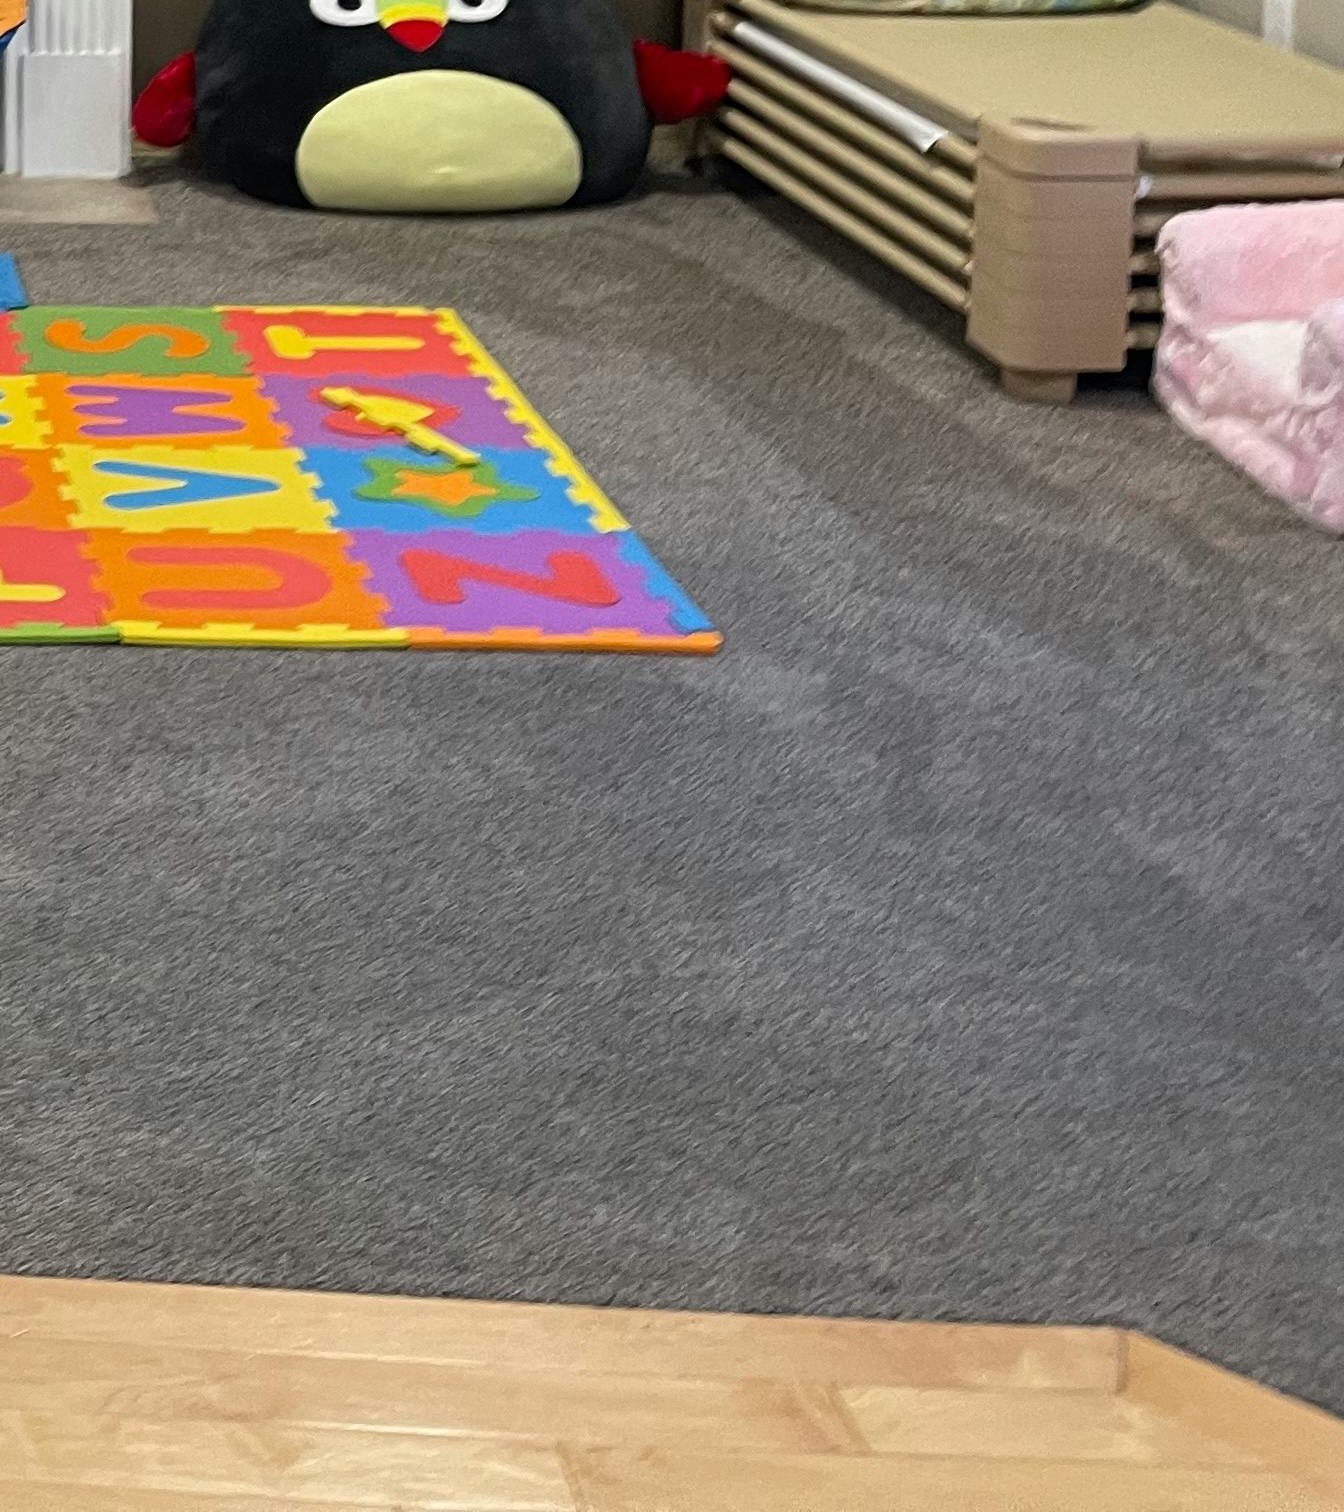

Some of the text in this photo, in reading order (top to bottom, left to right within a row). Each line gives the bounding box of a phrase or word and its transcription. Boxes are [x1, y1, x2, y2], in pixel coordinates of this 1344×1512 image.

[45, 319, 211, 359] S
[264, 324, 425, 360] T
[66, 383, 246, 437] W
[91, 458, 281, 511] V
[124, 546, 332, 610] U
[400, 547, 619, 606] Z
